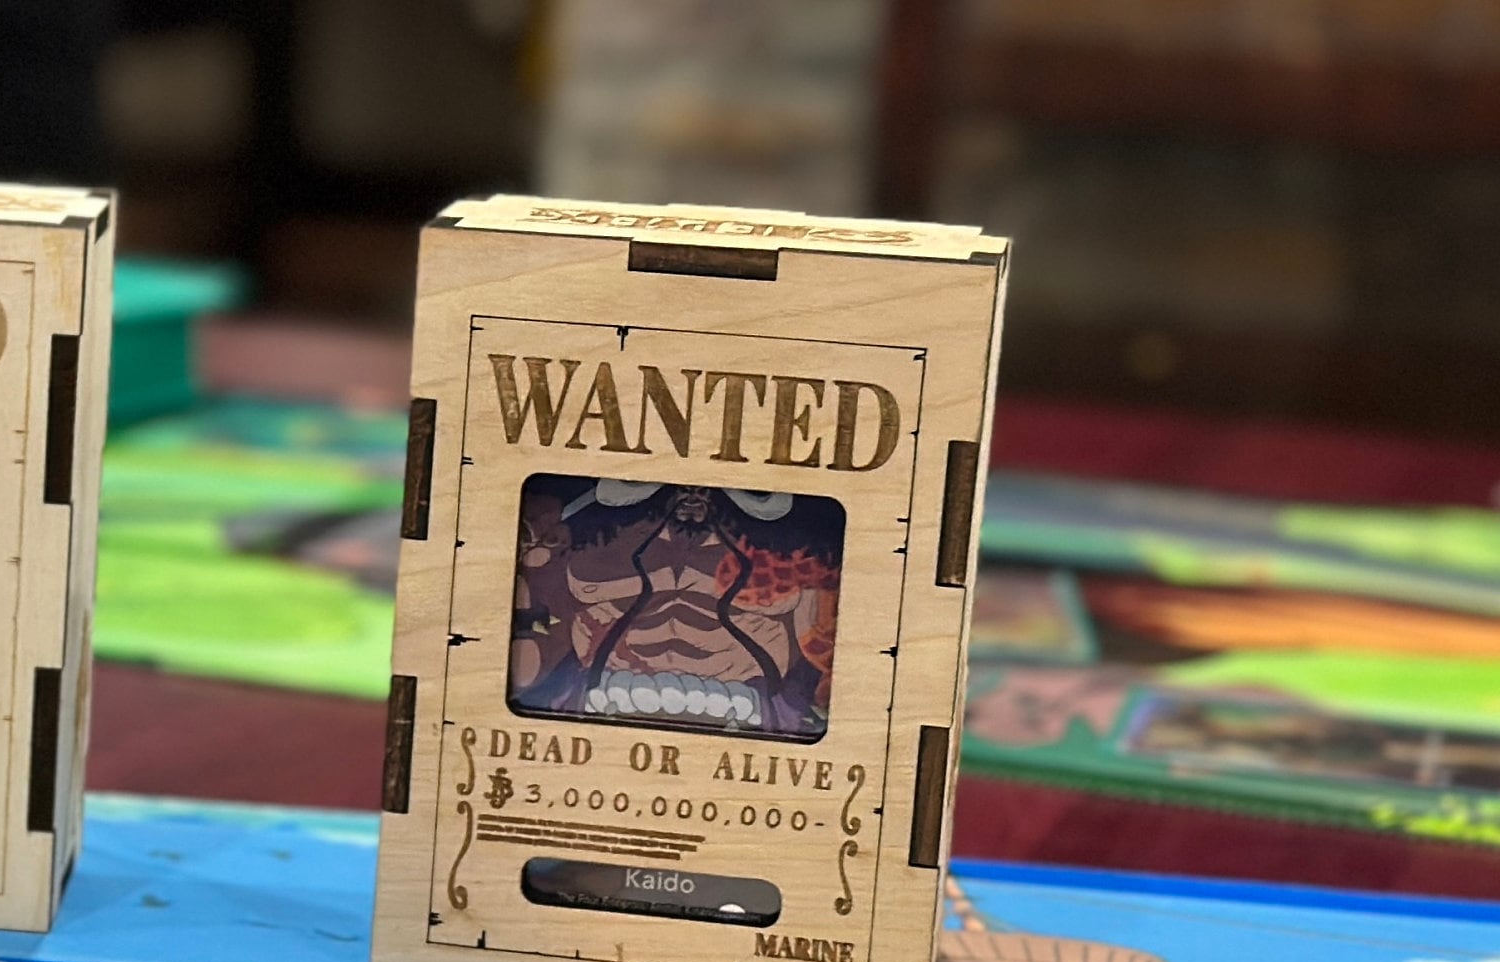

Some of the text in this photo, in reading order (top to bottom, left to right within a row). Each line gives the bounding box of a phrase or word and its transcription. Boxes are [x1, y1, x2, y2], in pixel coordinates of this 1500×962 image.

[488, 353, 901, 472] WANTED
[488, 729, 834, 790] DEAD OR ALIVE
[625, 868, 696, 894] Kaido
